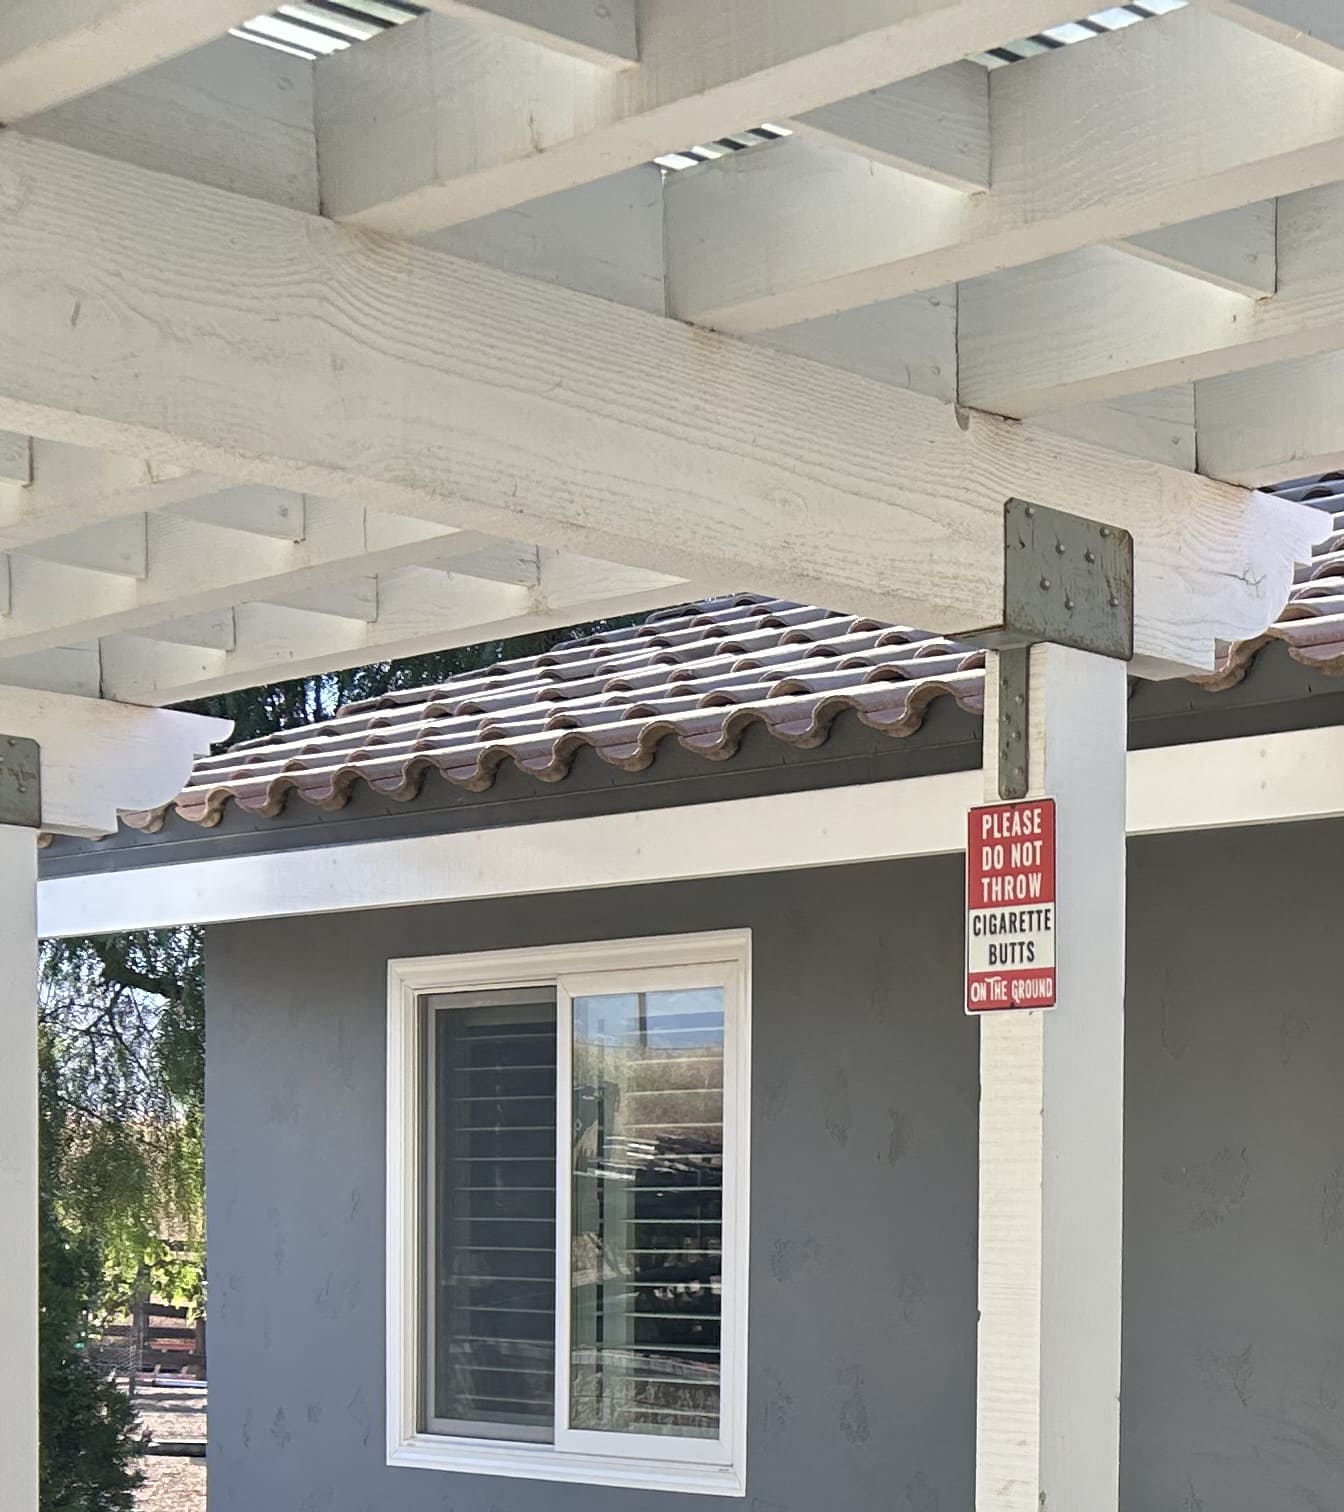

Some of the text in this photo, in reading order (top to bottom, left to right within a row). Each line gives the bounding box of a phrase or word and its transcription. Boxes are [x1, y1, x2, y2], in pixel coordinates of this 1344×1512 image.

[982, 808, 1041, 839] PLEASE
[982, 841, 1043, 871] DO NOT
[981, 873, 1042, 902] THROW
[973, 909, 1051, 936] CIGARETTE
[988, 941, 1035, 965] BUTTS
[971, 976, 1053, 1003] ON THE GROUND
